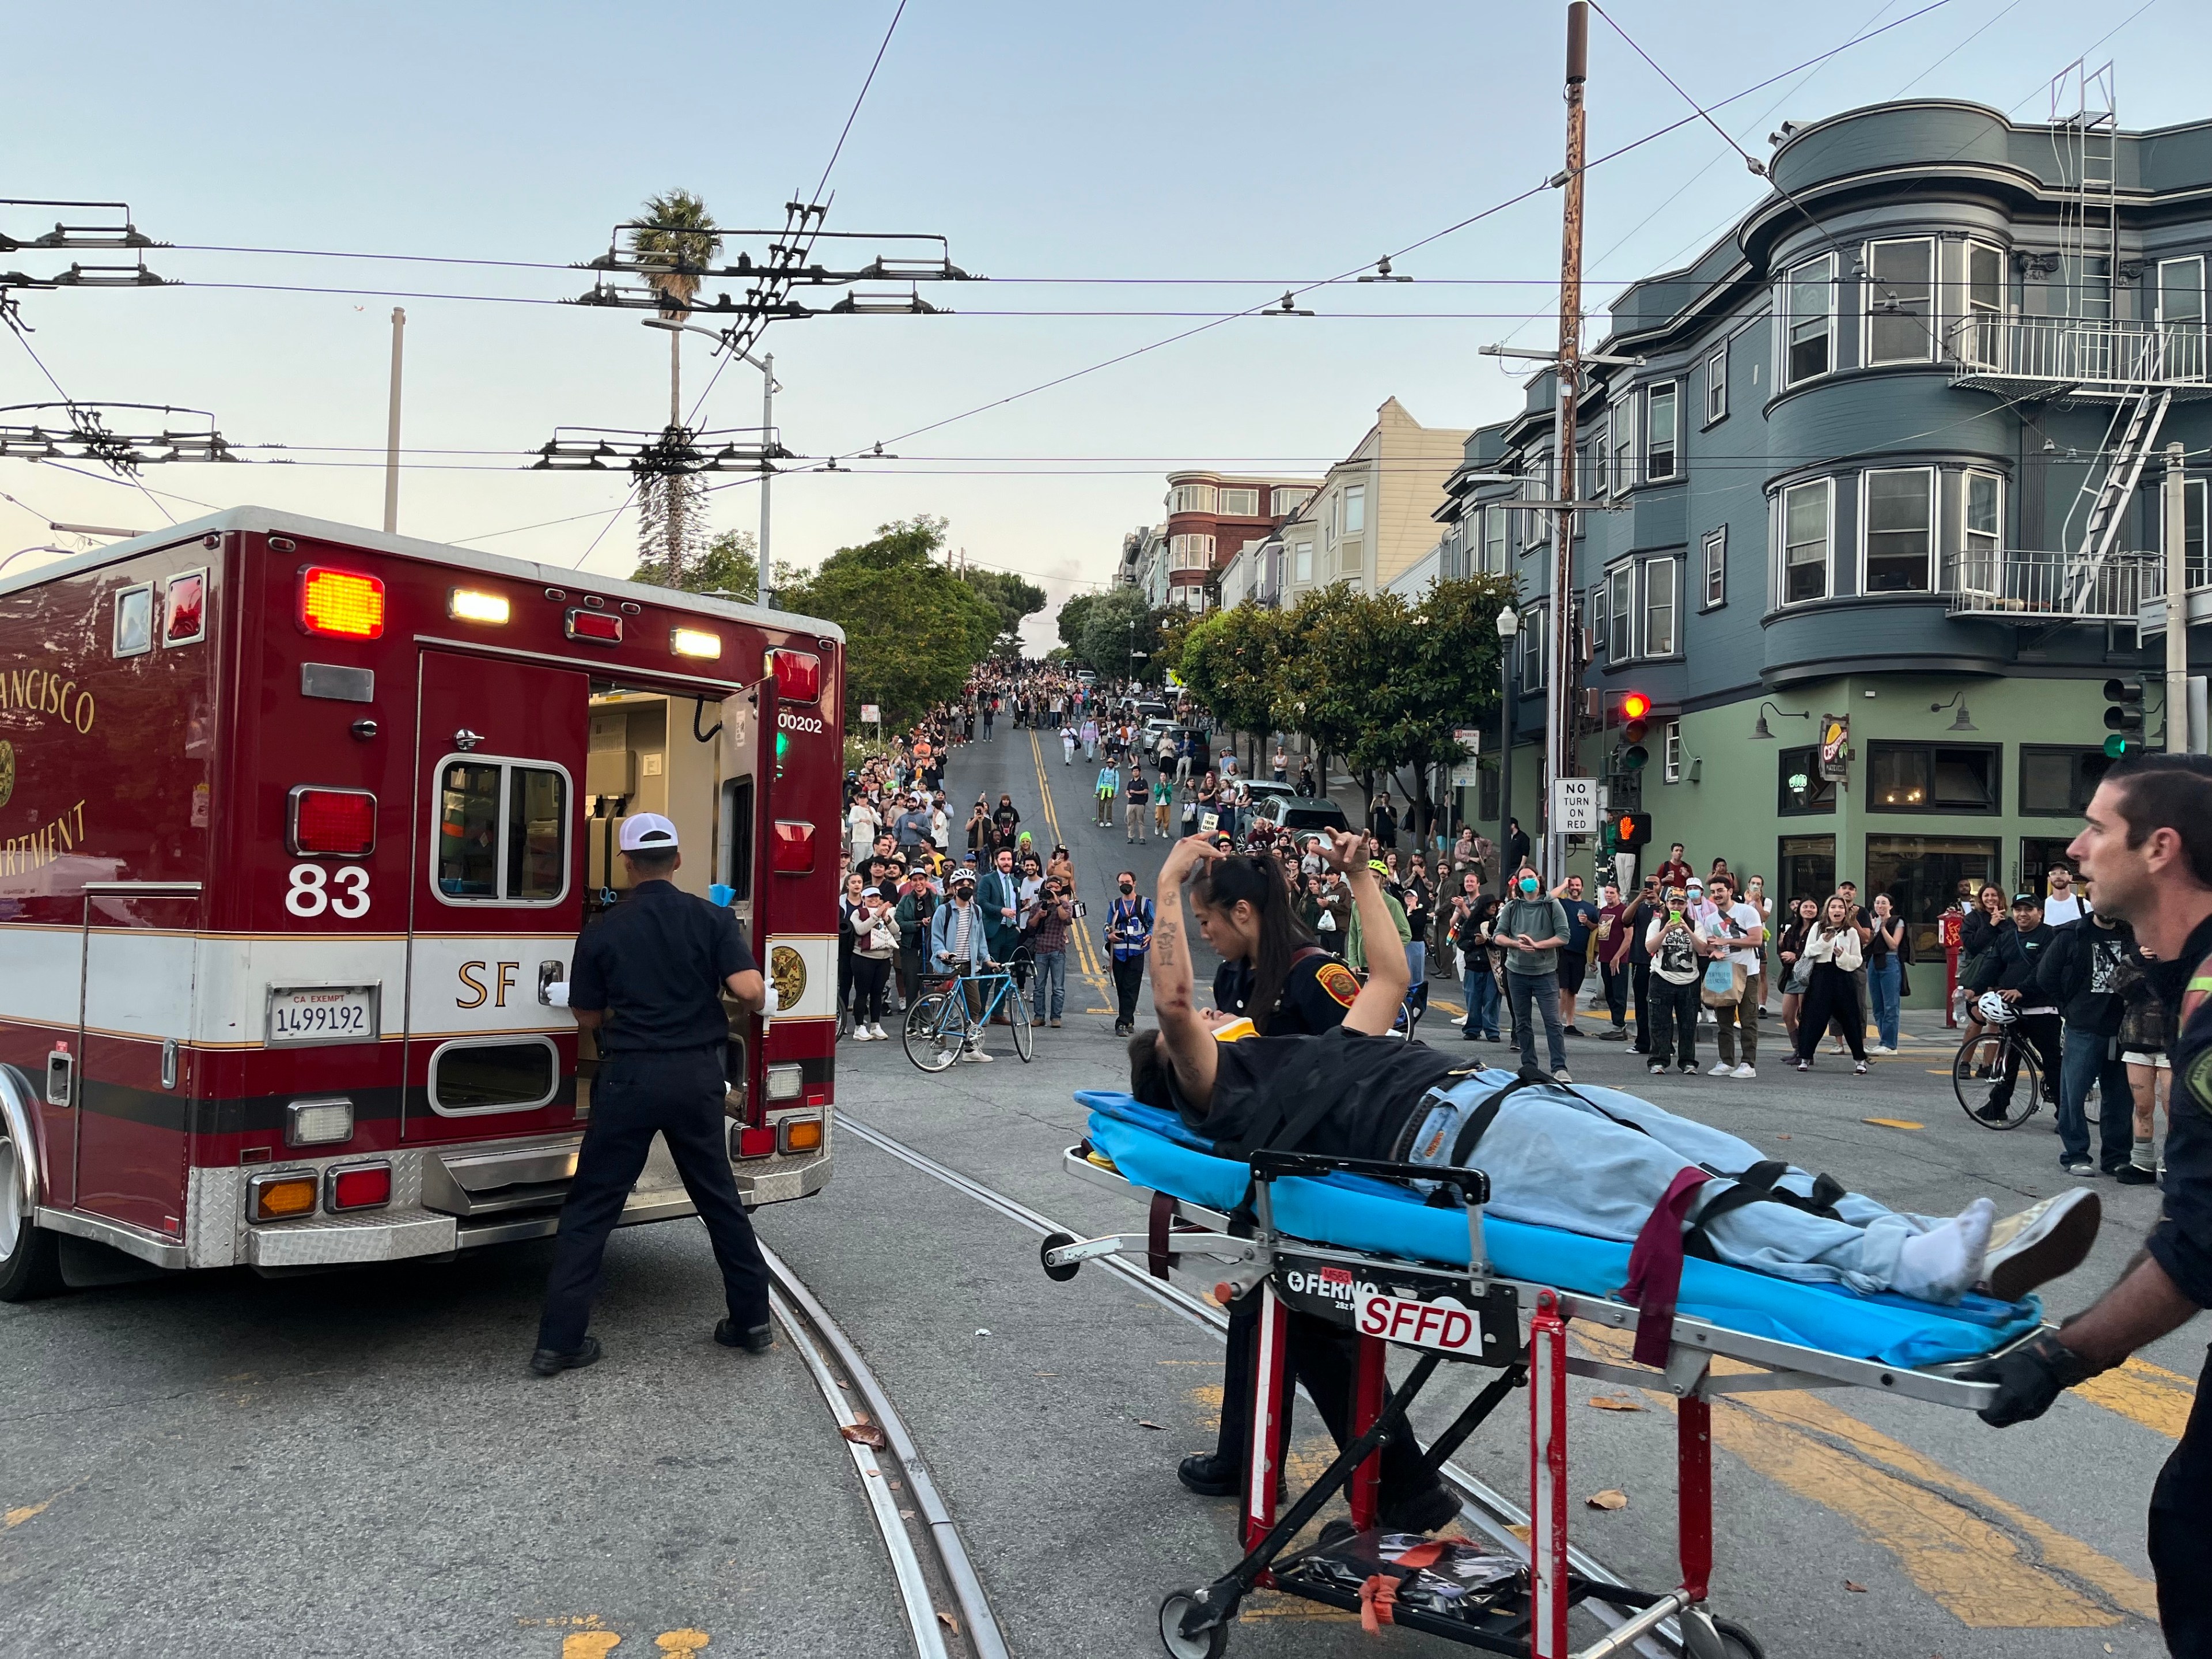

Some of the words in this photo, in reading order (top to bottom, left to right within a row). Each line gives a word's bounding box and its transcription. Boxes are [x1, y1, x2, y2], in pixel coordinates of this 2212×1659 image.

[778, 713, 822, 734] 00202
[1566, 783, 1586, 794] NO
[1563, 797, 1589, 806] TURN
[1570, 809, 1584, 817] ON
[1567, 820, 1586, 828] RED
[0, 799, 85, 877] RTMENT
[285, 863, 370, 918] 83
[456, 961, 520, 1009] SF
[311, 995, 344, 1003] EXEMPT
[277, 1006, 363, 1032] 1499192
[1362, 1297, 1472, 1348] SFFD
